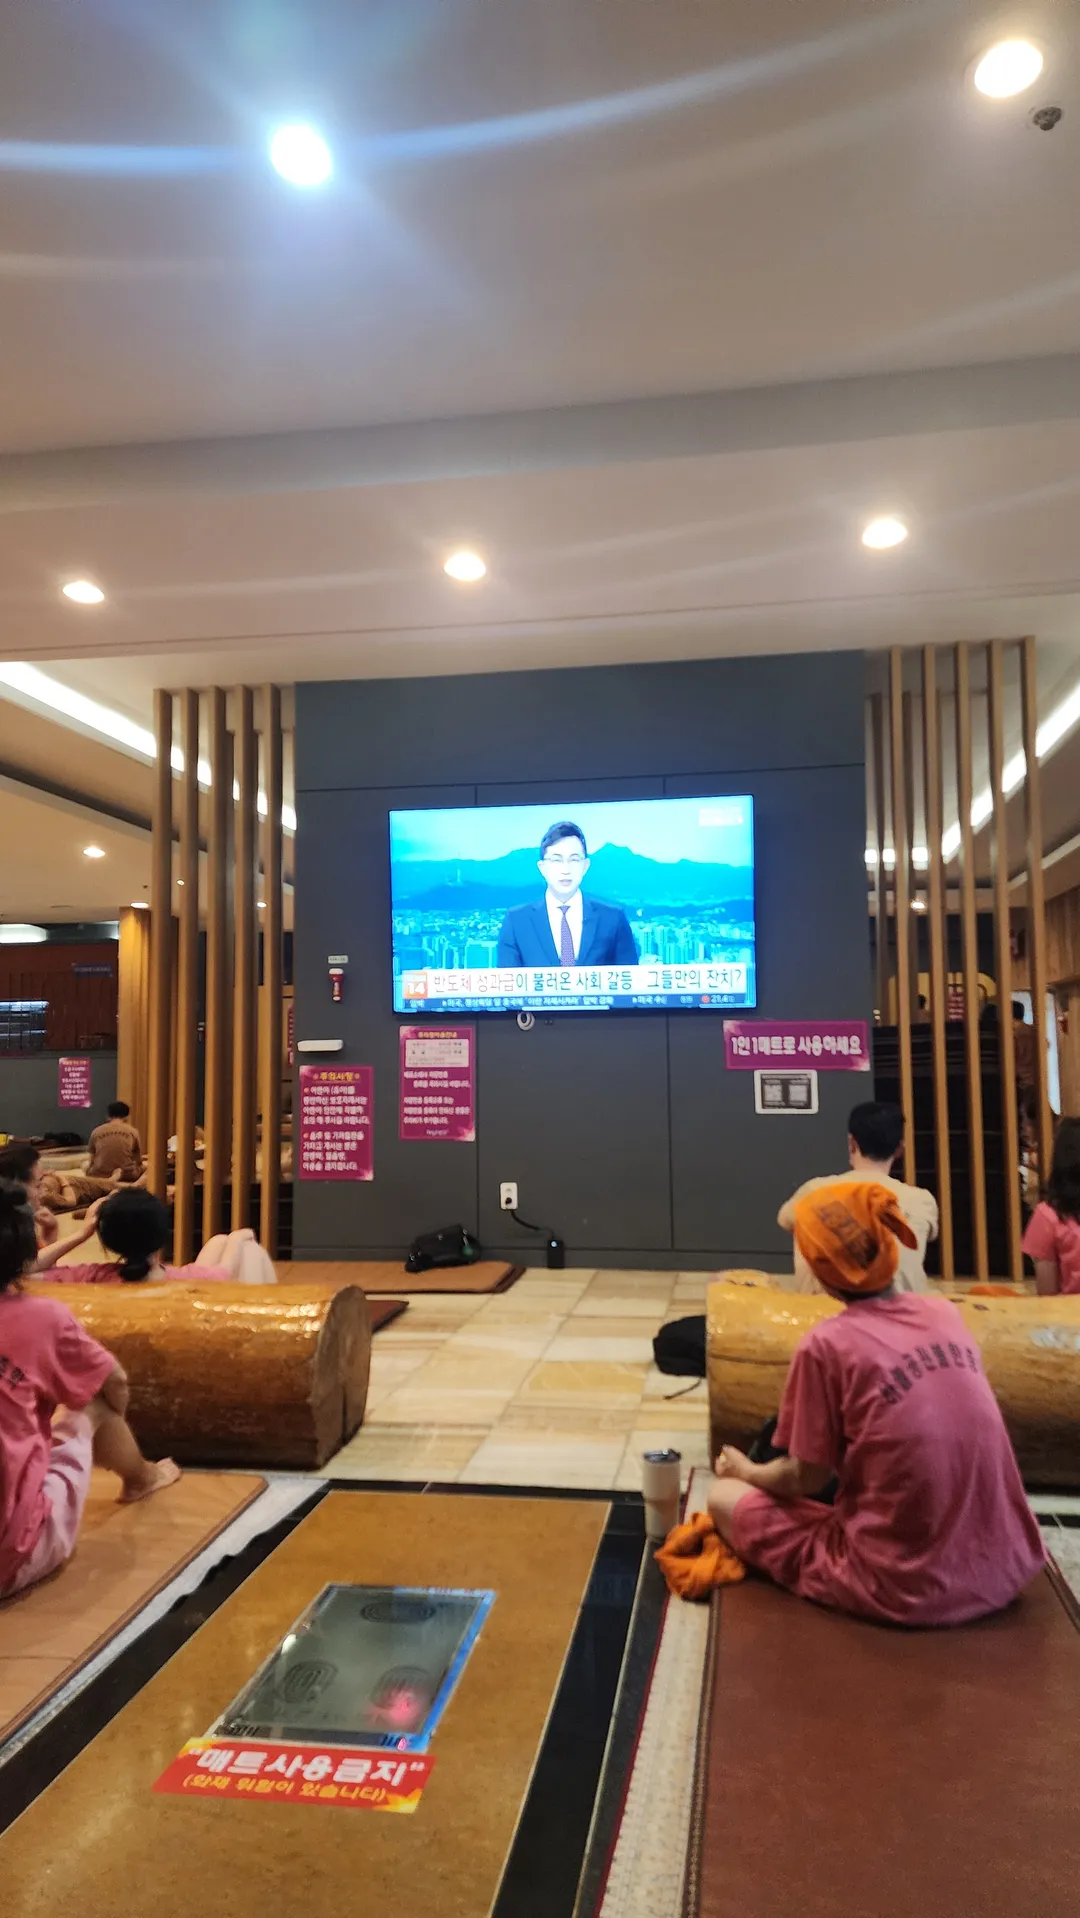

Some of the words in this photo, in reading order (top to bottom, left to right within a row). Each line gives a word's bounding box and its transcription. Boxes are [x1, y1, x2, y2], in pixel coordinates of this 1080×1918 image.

[434, 974, 472, 994] 반도체
[477, 973, 529, 993] 성과급이
[533, 971, 572, 991] 불러온
[576, 971, 602, 990] 사회
[648, 969, 701, 989] 그들만의
[706, 968, 743, 988] 잔치?
[797, 1034, 863, 1057] 사용하세요
[319, 1071, 355, 1081] 주의사항
[182, 1773, 232, 1790] (화재
[236, 1776, 295, 1795] 위험이
[299, 1780, 387, 1802] 있습니다)
